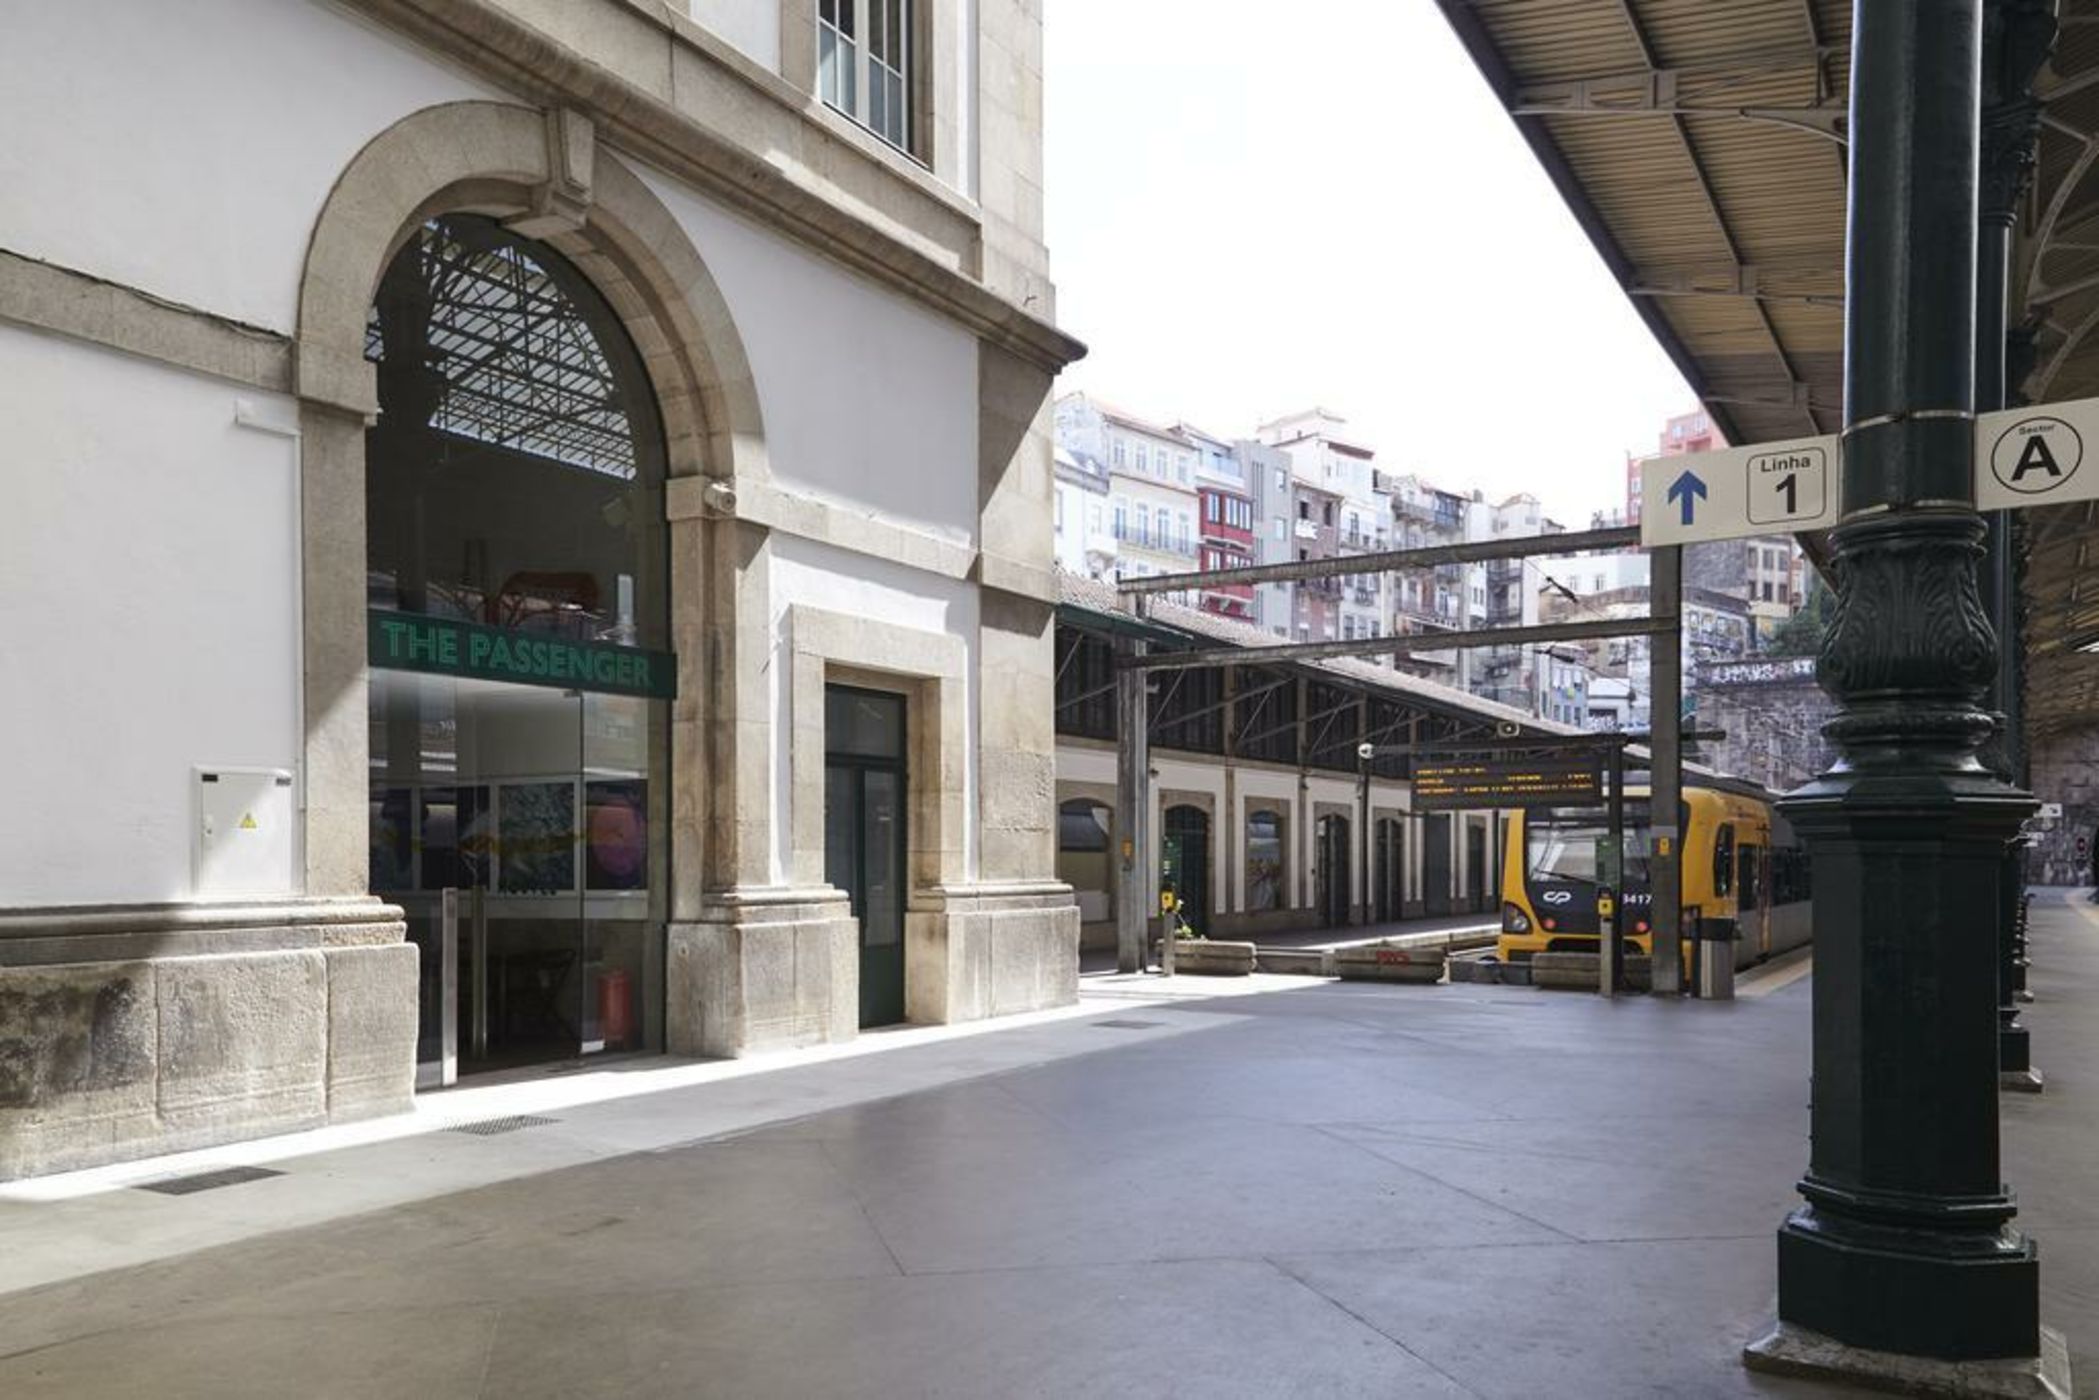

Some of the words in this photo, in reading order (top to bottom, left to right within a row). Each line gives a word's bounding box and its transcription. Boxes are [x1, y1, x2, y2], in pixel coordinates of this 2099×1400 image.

[1761, 456, 1811, 473] Linha
[2010, 435, 2062, 481] A
[1776, 473, 1796, 514] 1
[381, 620, 458, 666] THE
[470, 633, 653, 687] PASSENGER
